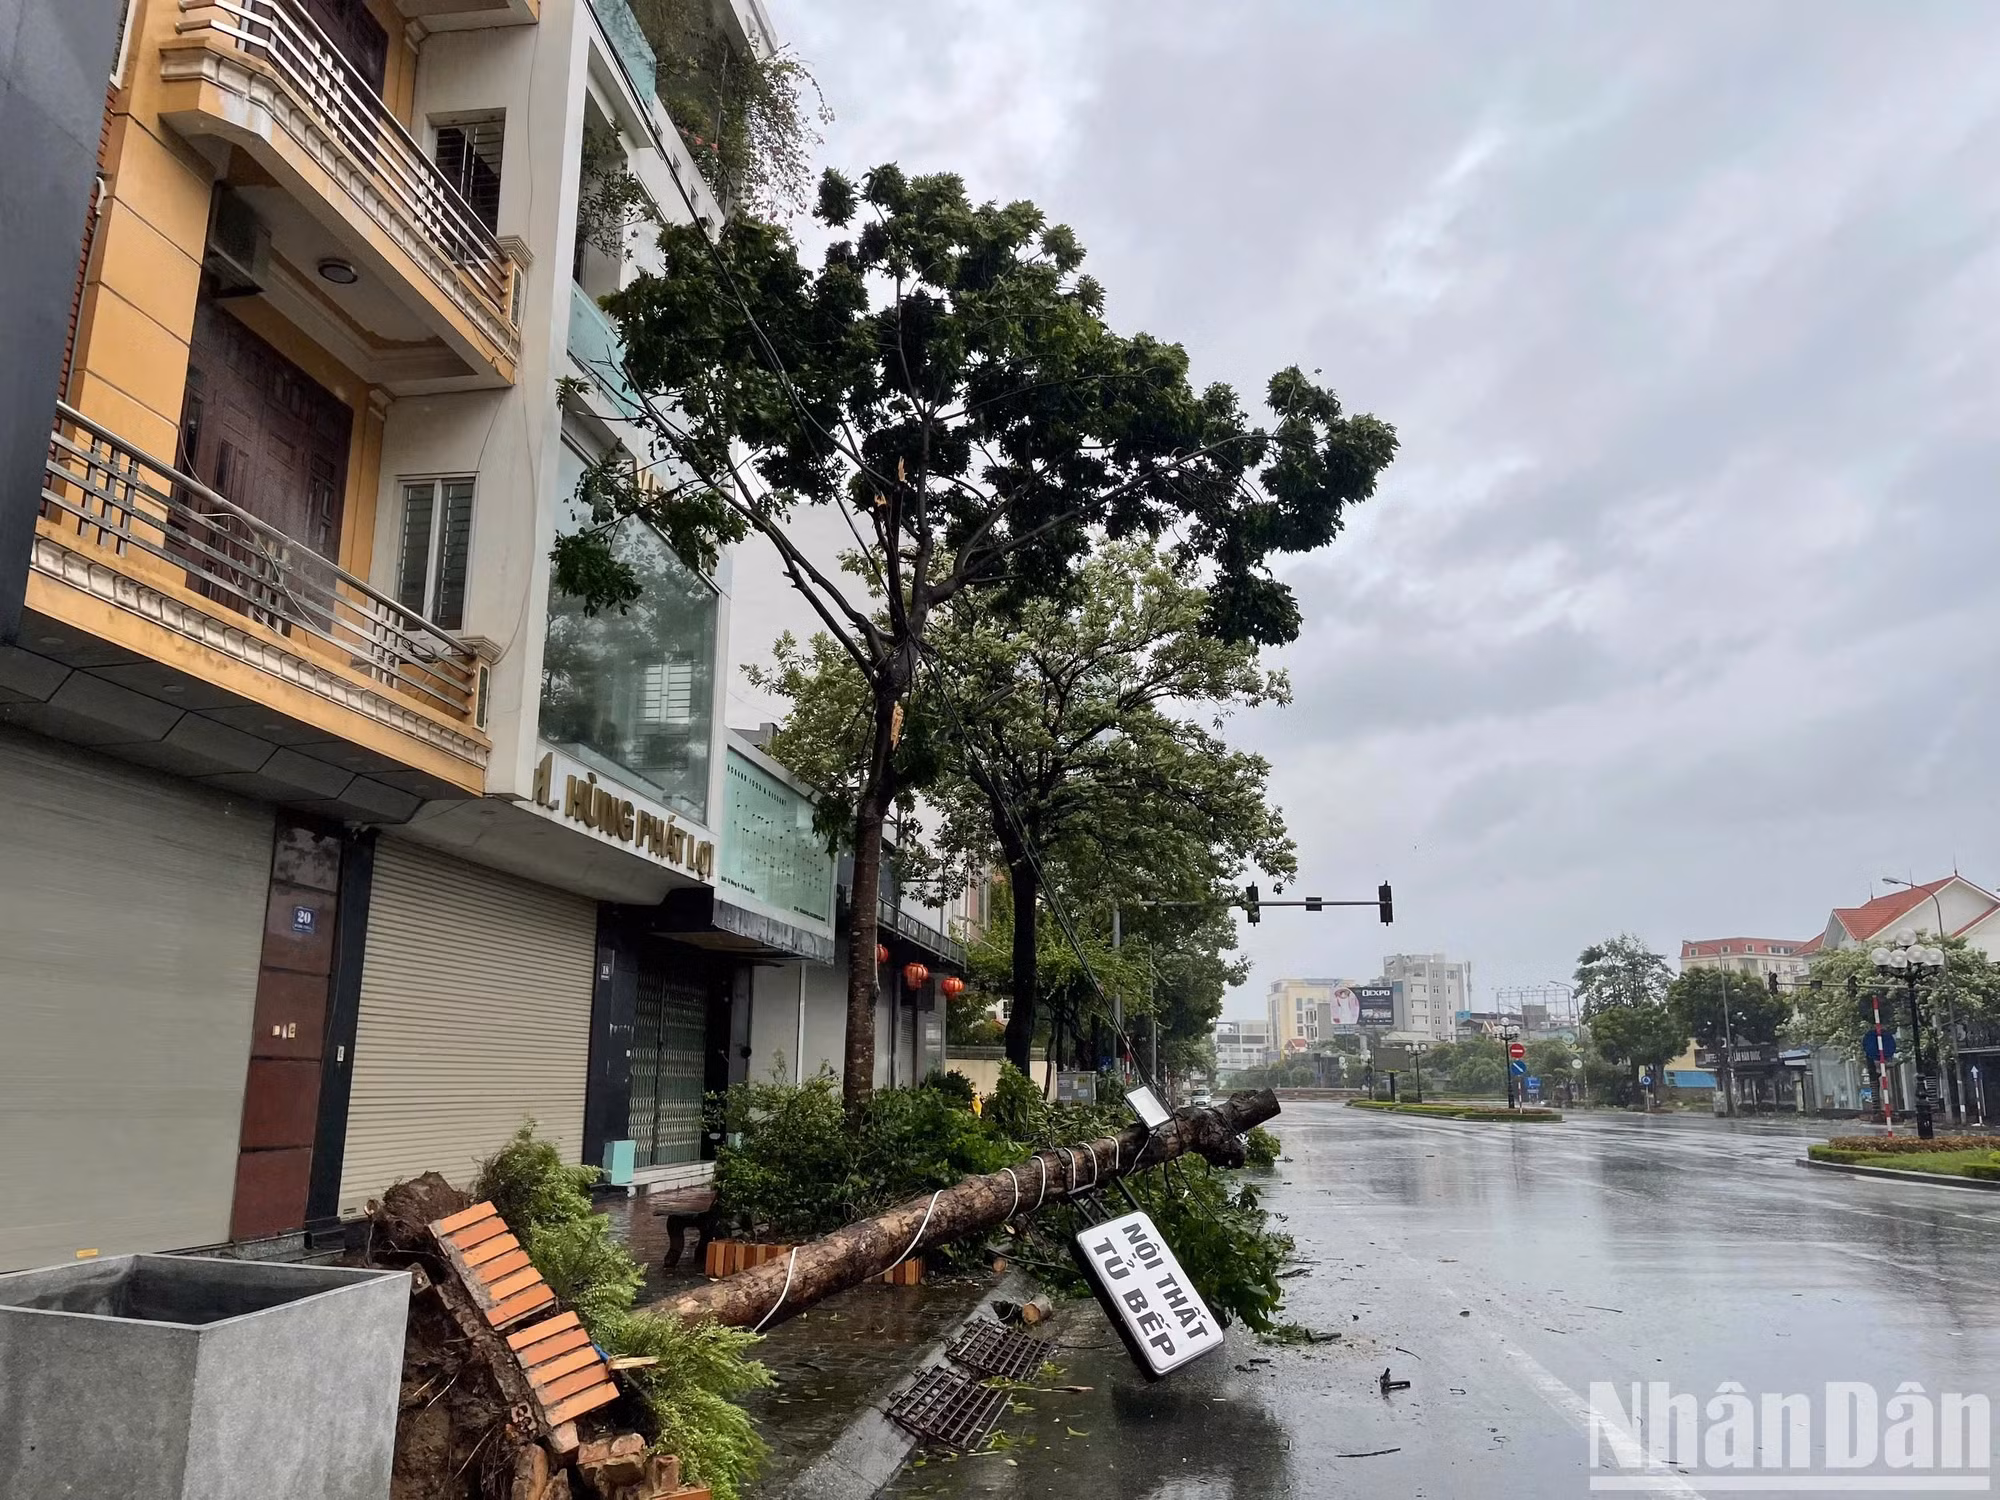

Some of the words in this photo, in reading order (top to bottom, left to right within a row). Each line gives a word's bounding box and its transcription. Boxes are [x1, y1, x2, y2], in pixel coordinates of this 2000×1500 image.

[565, 772, 634, 841] HÙNG
[635, 810, 687, 864] PHÁT
[687, 834, 714, 881] LỢI
[297, 910, 311, 924] 20
[1093, 1237, 1135, 1280] TỦ
[1122, 1288, 1176, 1356] BẾP
[1122, 1223, 1164, 1270] NỘI
[1156, 1272, 1208, 1339] THẤT
